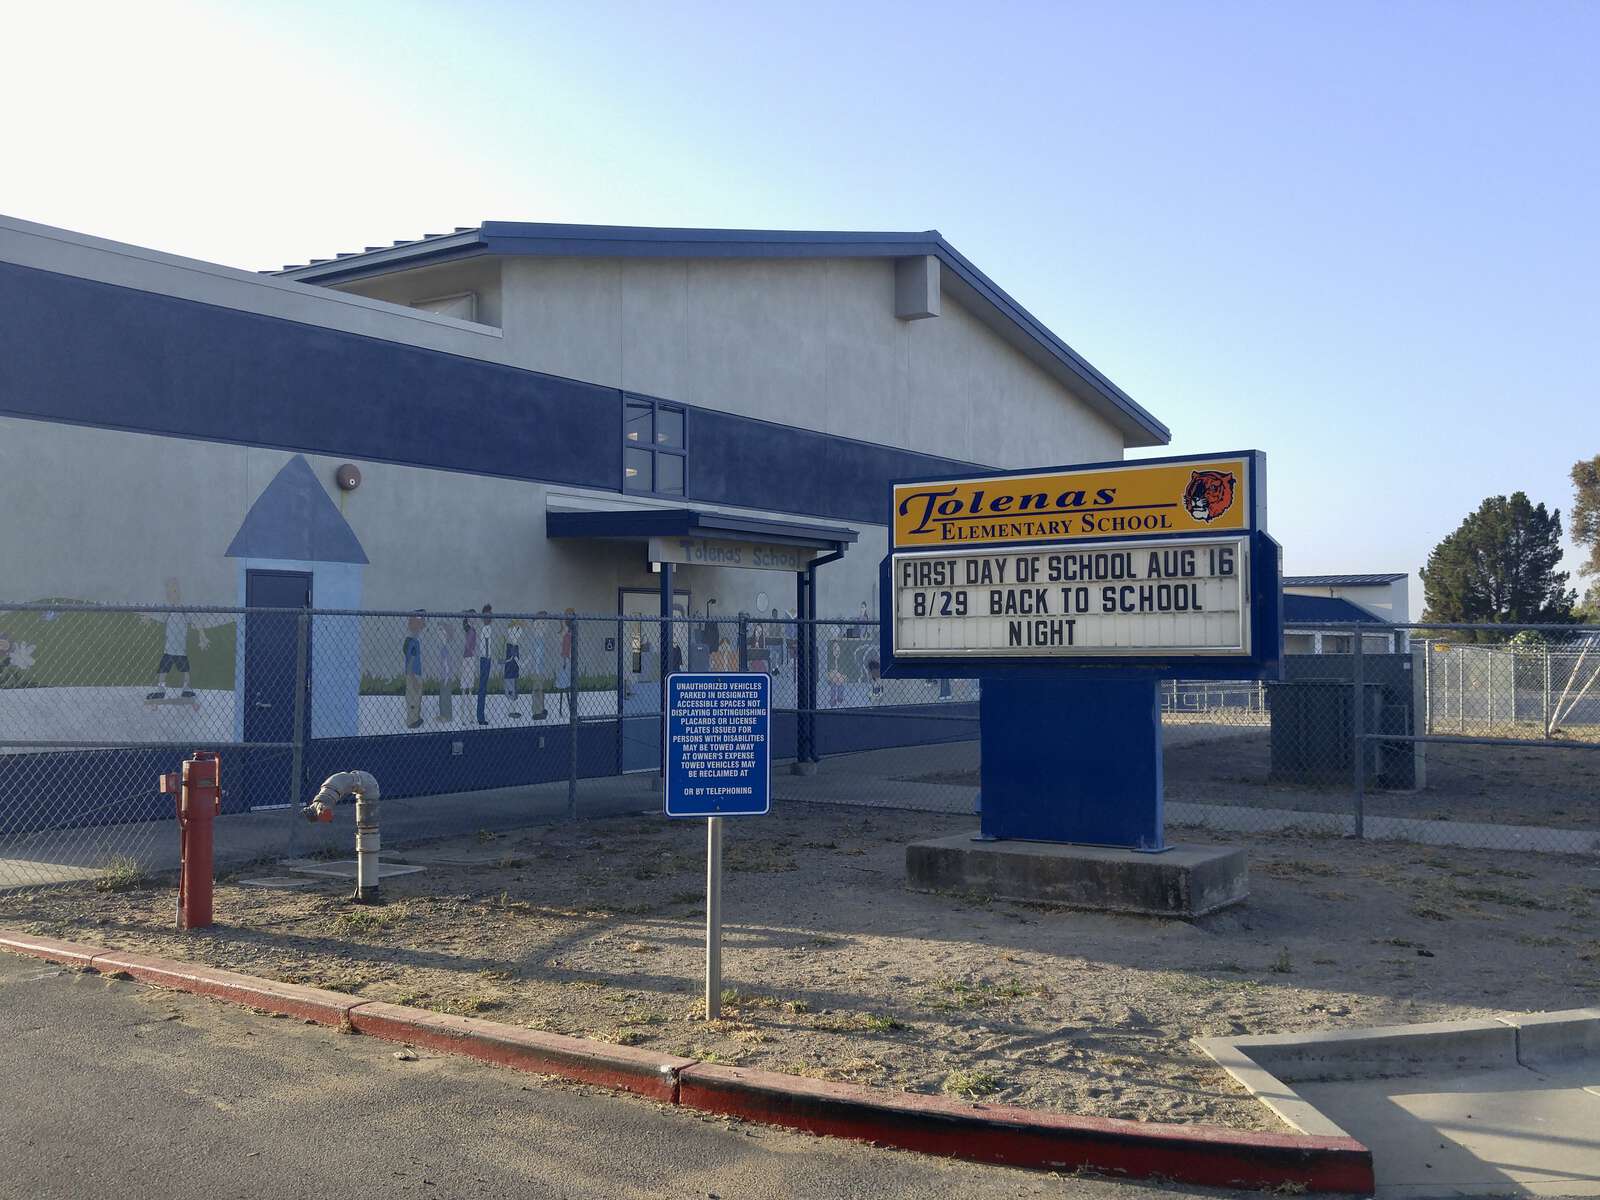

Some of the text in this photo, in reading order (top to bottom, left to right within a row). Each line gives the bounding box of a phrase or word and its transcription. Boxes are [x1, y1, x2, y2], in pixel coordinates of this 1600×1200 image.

[900, 487, 1117, 535] Tolenas
[680, 540, 802, 568] Tolenas School
[903, 547, 1234, 586] FIRST DAY OF SCHOOL AUG 16
[914, 583, 1203, 616] 8/29 BACK TO SCHOOL
[1009, 619, 1076, 646] NIGHT
